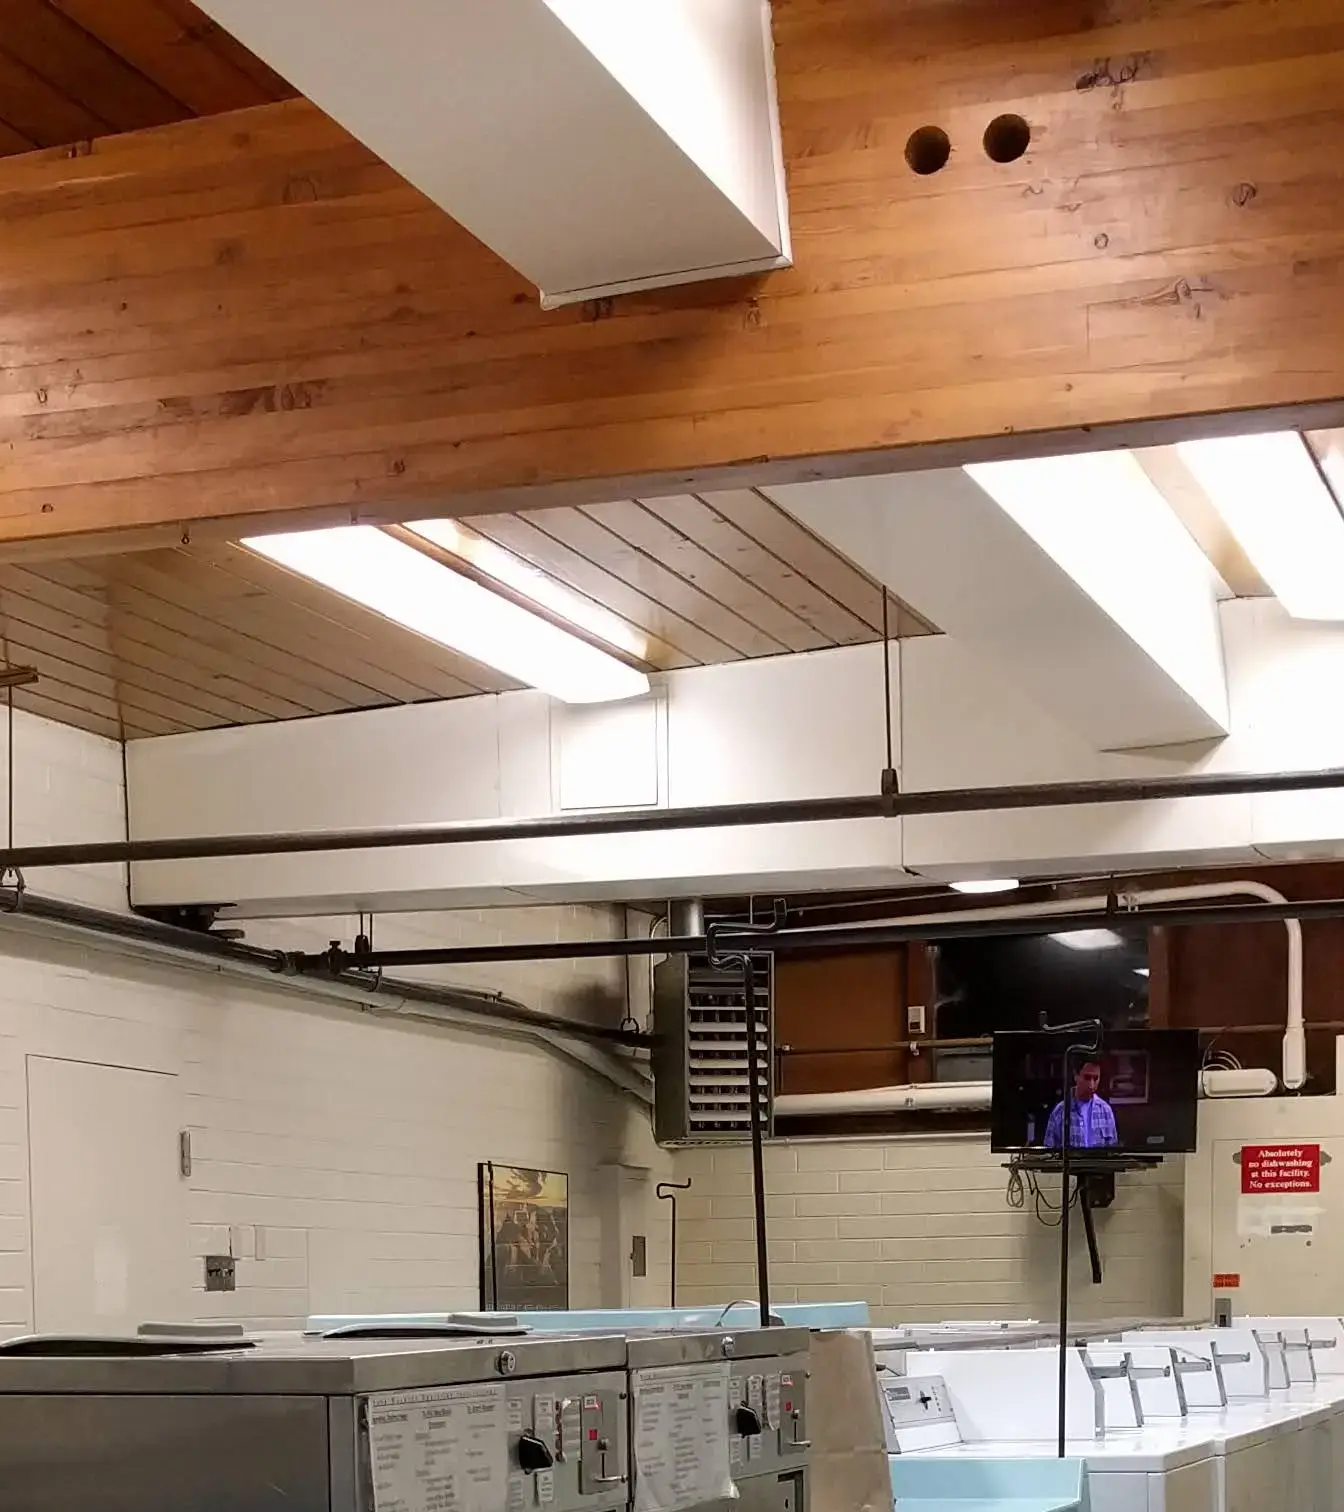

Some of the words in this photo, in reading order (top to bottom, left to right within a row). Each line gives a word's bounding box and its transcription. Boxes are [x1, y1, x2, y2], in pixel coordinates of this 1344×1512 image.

[1258, 1149, 1303, 1158] Absolutely
[1261, 1159, 1313, 1168] dishwashing
[1261, 1170, 1277, 1178] this
[1249, 1180, 1263, 1188] No
[1264, 1180, 1312, 1189] exceptions.
